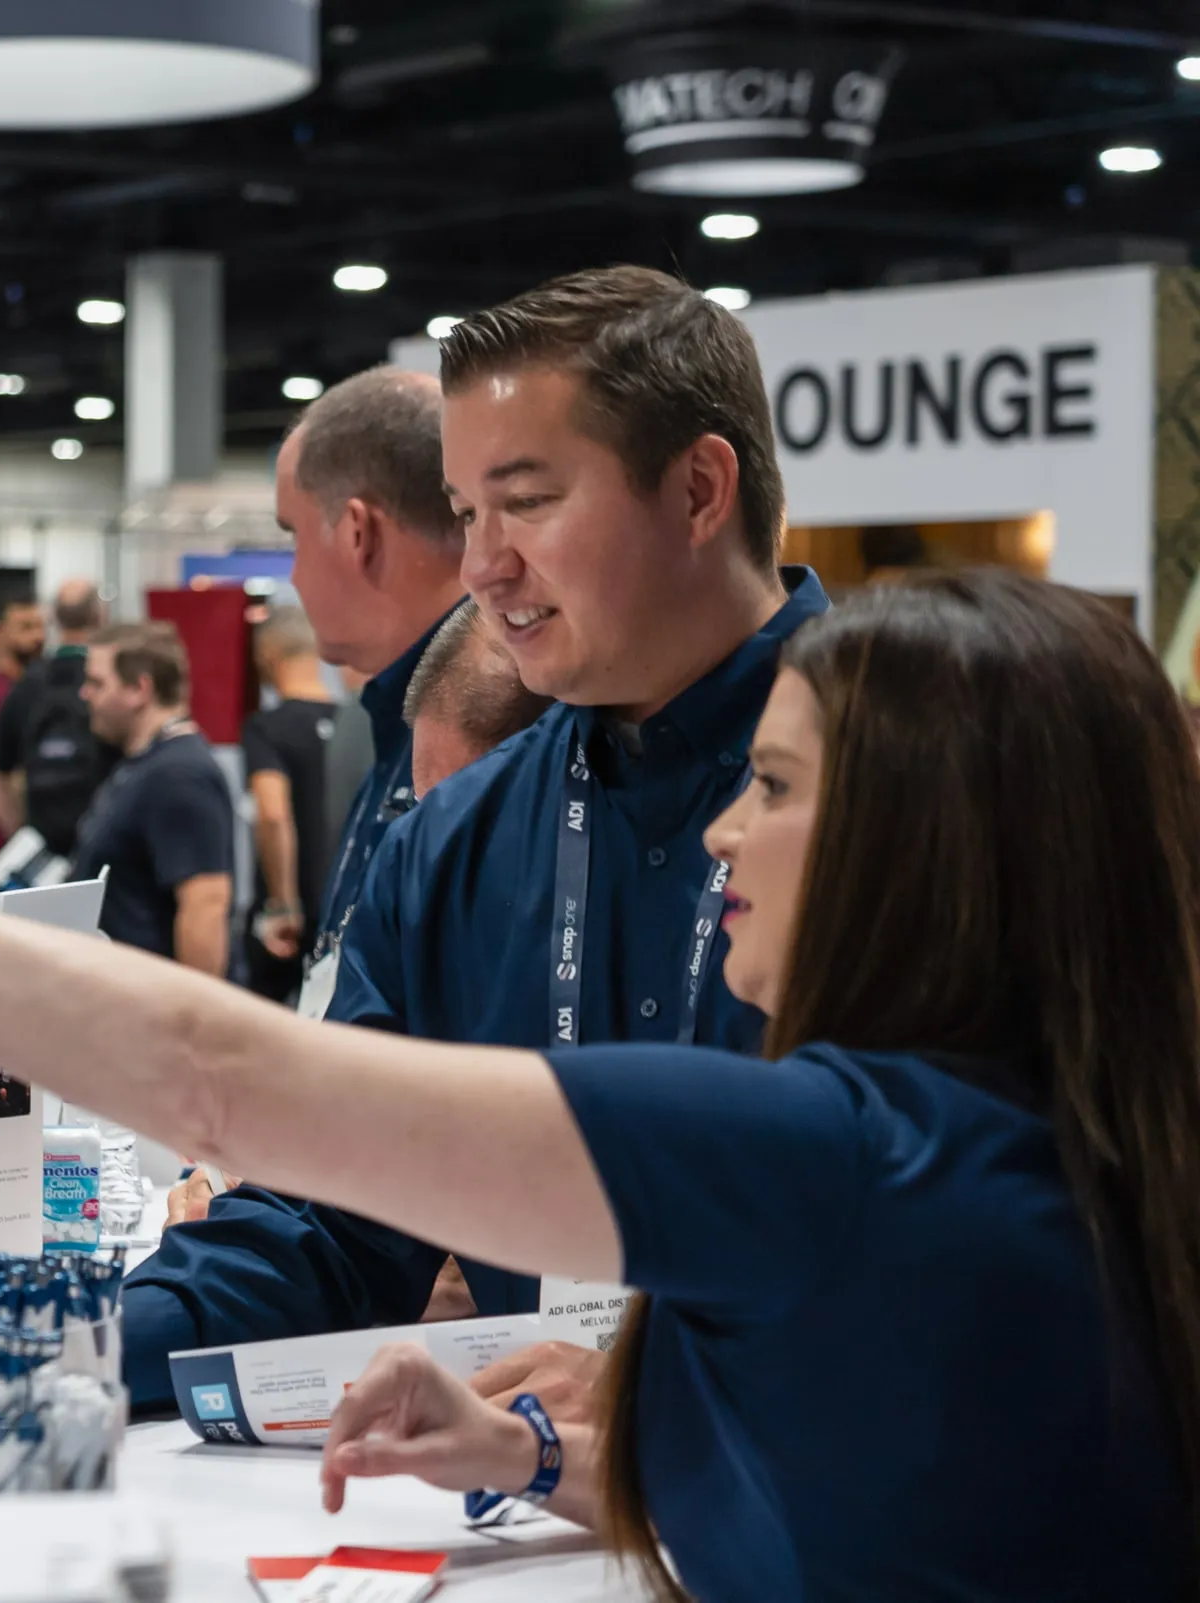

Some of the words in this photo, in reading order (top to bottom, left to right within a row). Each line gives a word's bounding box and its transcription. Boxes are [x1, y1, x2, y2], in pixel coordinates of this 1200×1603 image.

[567, 801, 585, 832] ADI
[565, 896, 577, 925] one
[562, 926, 578, 961] snap
[689, 938, 705, 977] snap
[557, 1006, 573, 1041] ADI
[548, 1307, 564, 1317] ADI
[566, 1302, 606, 1314] GLOBAL
